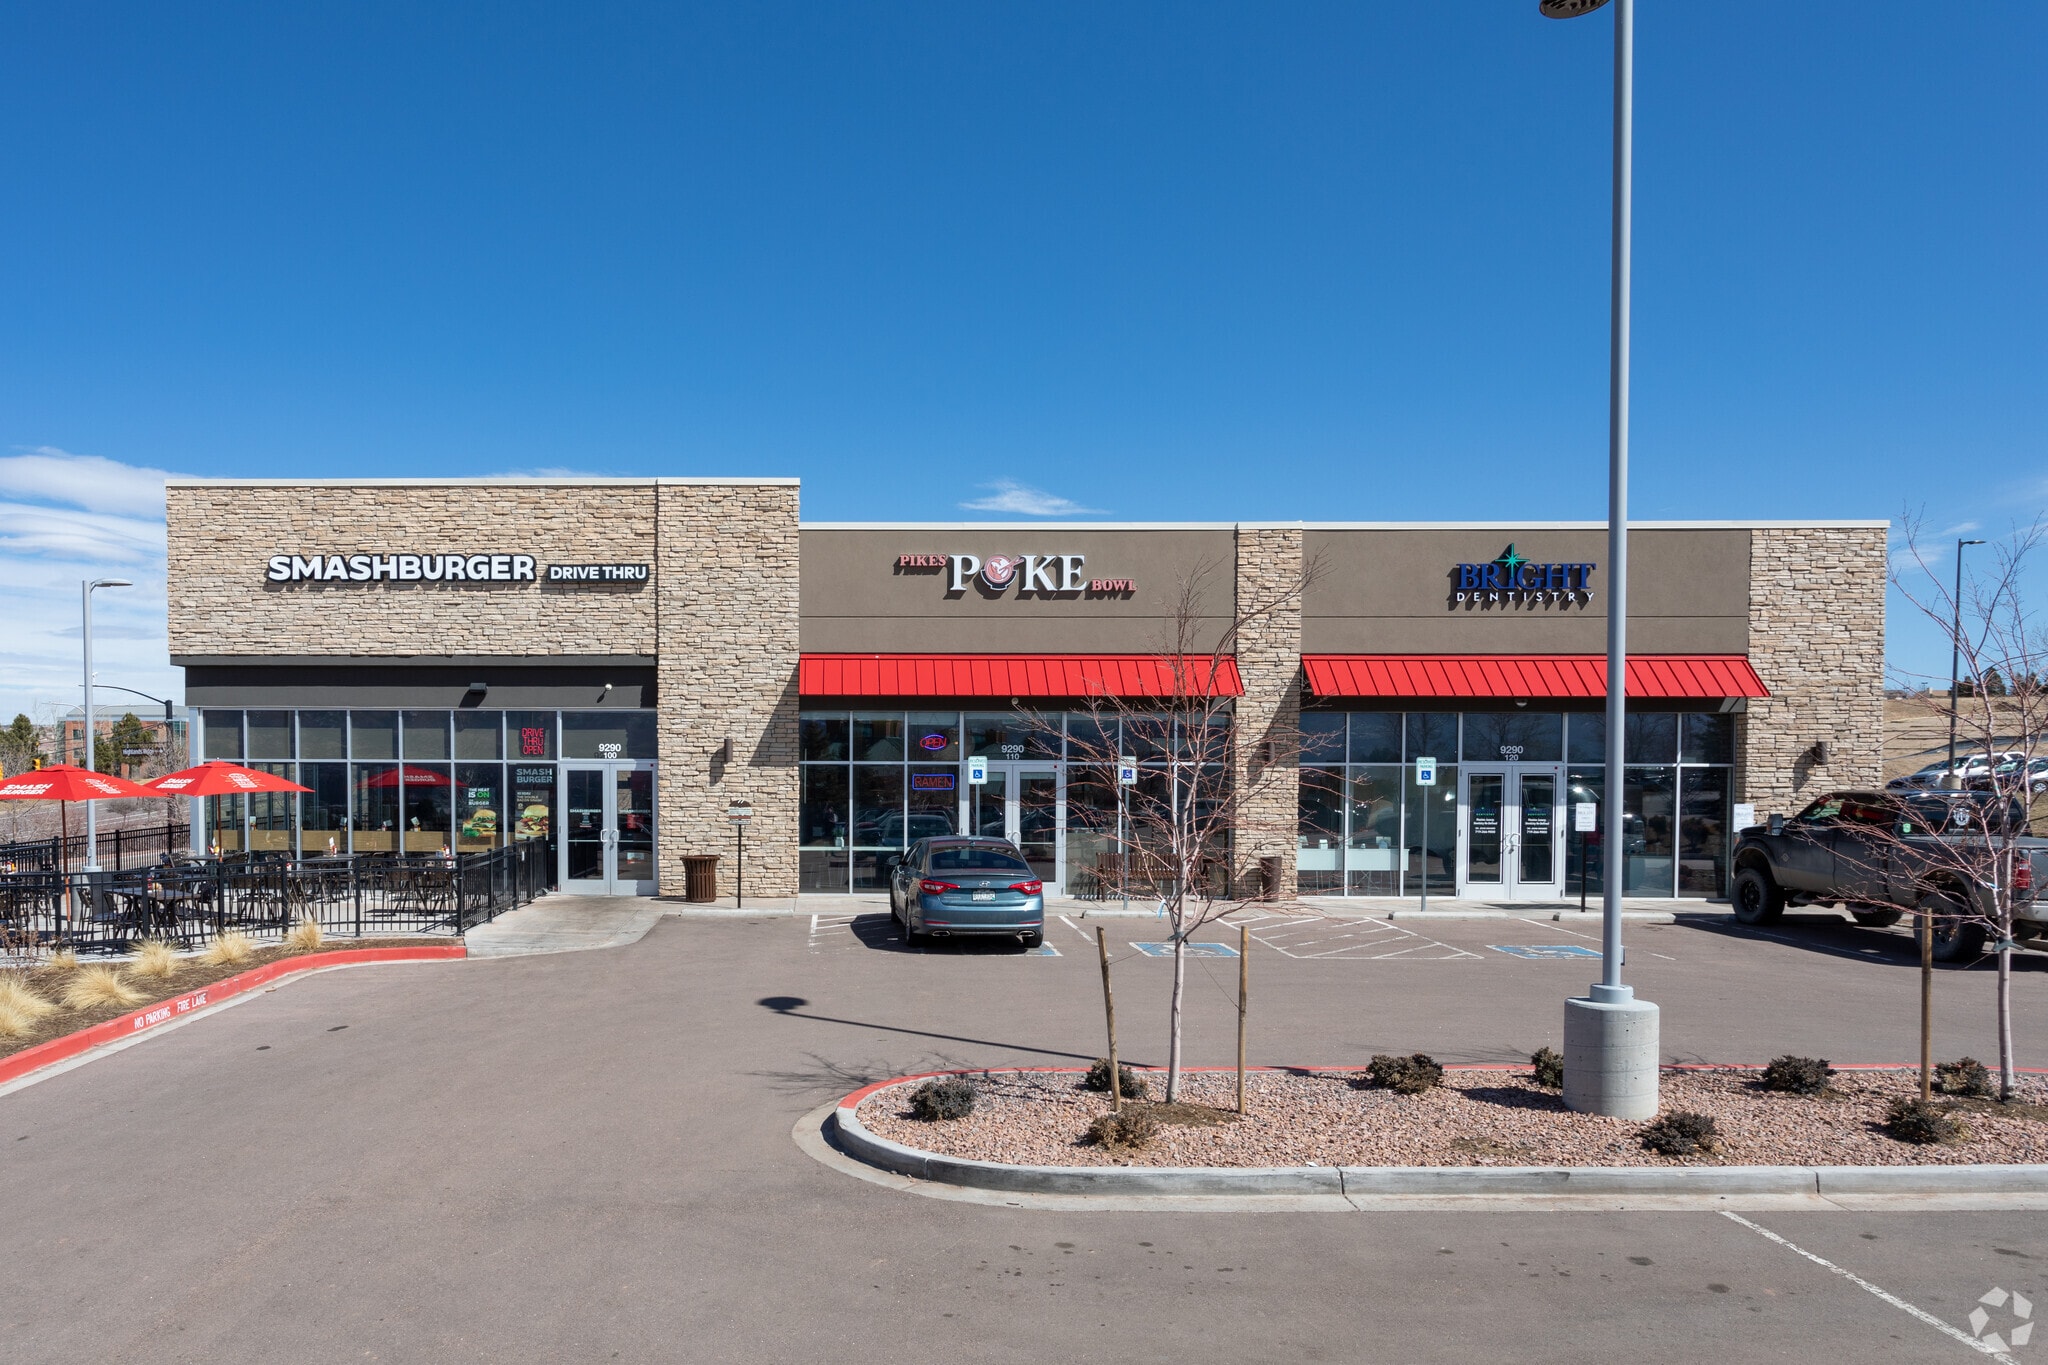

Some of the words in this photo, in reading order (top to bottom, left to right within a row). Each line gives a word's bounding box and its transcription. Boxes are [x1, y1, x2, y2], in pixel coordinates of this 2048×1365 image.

[268, 554, 536, 582] SMASHBURGER
[549, 566, 600, 580] DRIVE
[602, 565, 647, 580] THRU
[899, 554, 947, 567] PIKES
[1091, 579, 1137, 591] BOWL
[1456, 561, 1596, 590] BRIGHT
[1456, 592, 1595, 602] DENTISTRY
[521, 727, 544, 737] DRIVE
[523, 737, 544, 746] THRU
[920, 737, 947, 748] OPEN
[523, 745, 545, 755] OPEN
[599, 743, 622, 752] 9290
[1001, 744, 1025, 753] 9290
[1500, 745, 1524, 754] 9290
[515, 768, 553, 776] SMASH
[516, 775, 553, 783] BURGER
[914, 776, 952, 788] RAMEN
[134, 1017, 144, 1029] NO
[145, 1007, 171, 1025] PARKING
[177, 999, 190, 1013] FIRE
[191, 993, 207, 1008] LANE
